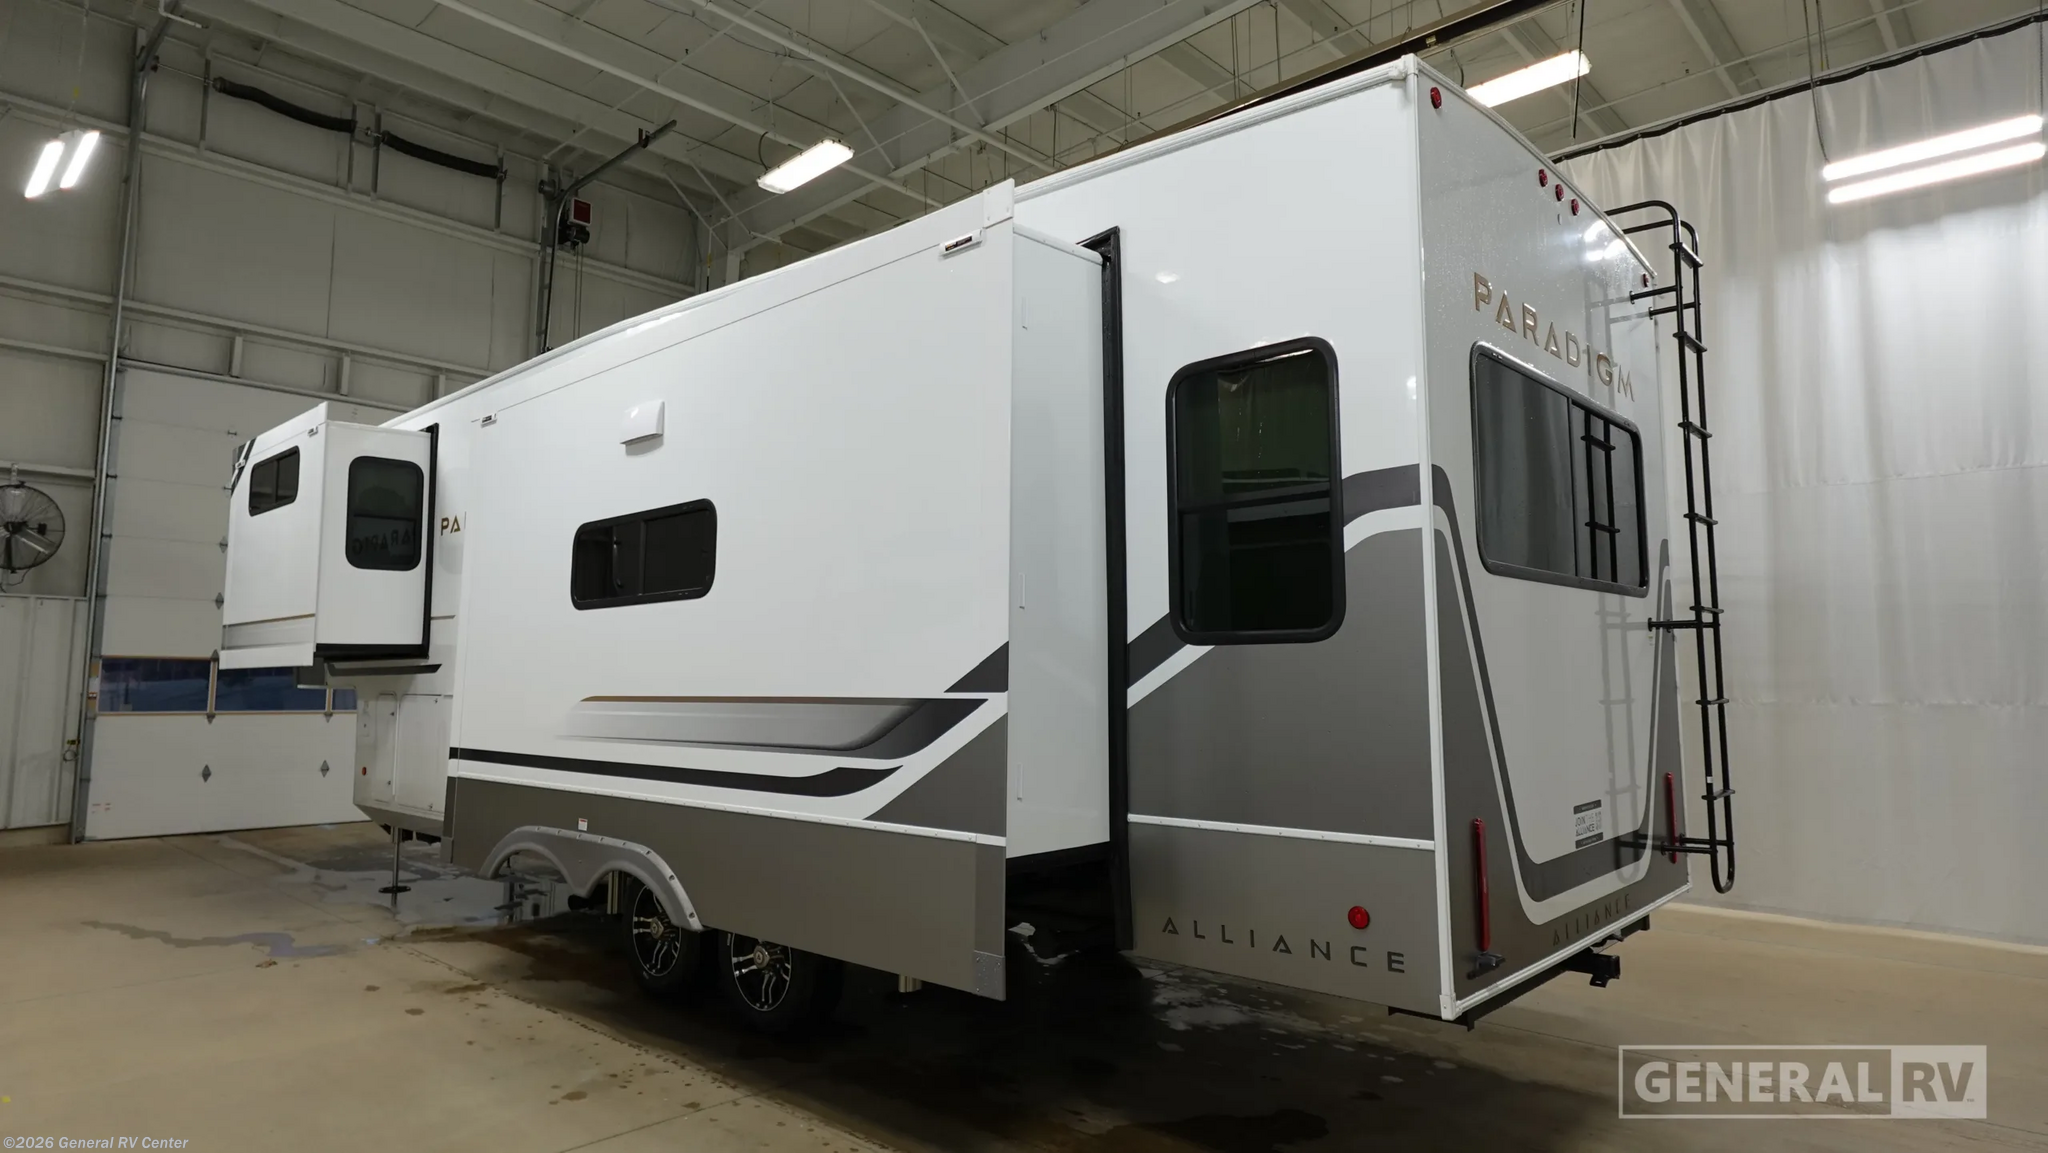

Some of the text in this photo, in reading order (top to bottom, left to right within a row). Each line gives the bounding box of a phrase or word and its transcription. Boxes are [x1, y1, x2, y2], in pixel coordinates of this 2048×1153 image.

[1474, 272, 1635, 402] PARADIGM
[440, 513, 466, 536] PA
[1162, 917, 1405, 973] ALLIANCE
[1553, 893, 1630, 946] ALLIANCE
